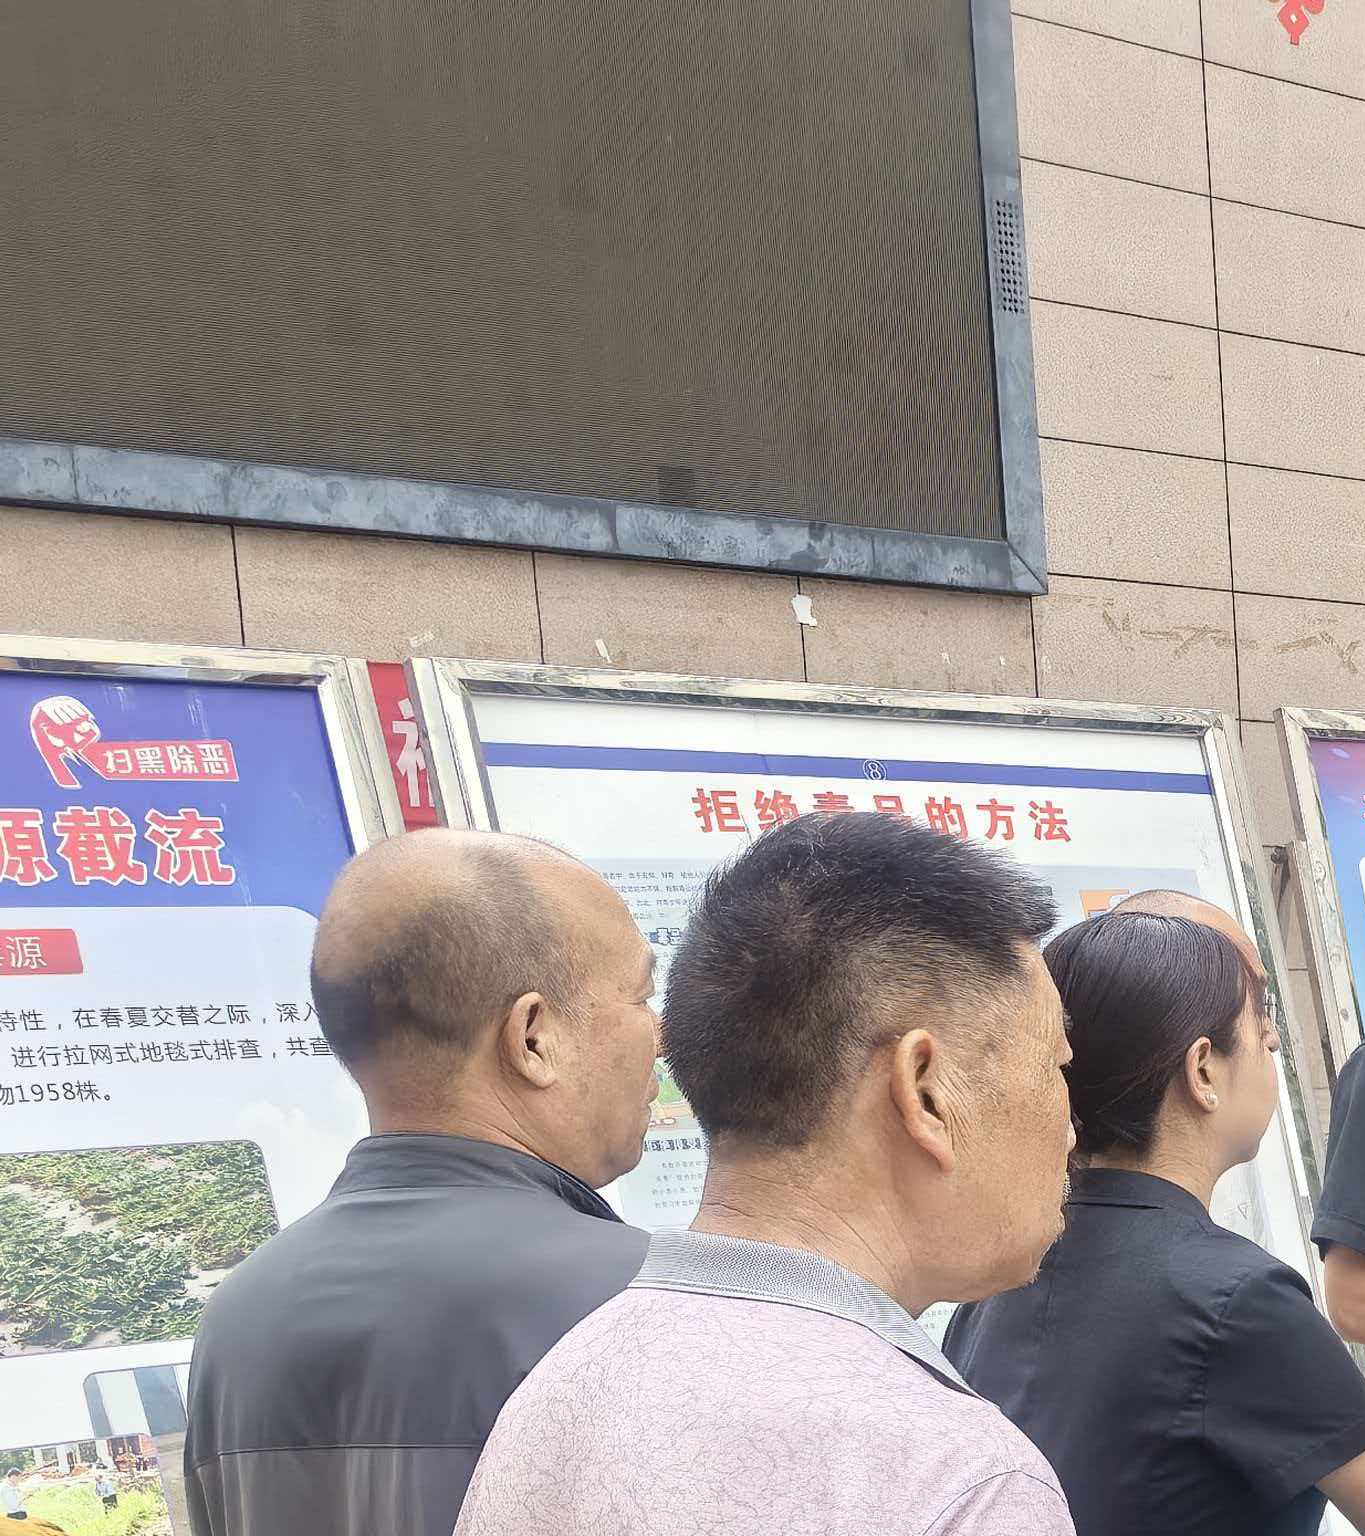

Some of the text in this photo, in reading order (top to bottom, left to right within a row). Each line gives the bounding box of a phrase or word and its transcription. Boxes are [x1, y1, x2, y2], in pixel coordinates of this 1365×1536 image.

[104, 743, 230, 775] 扫黑除恶
[0, 935, 47, 970] 源
